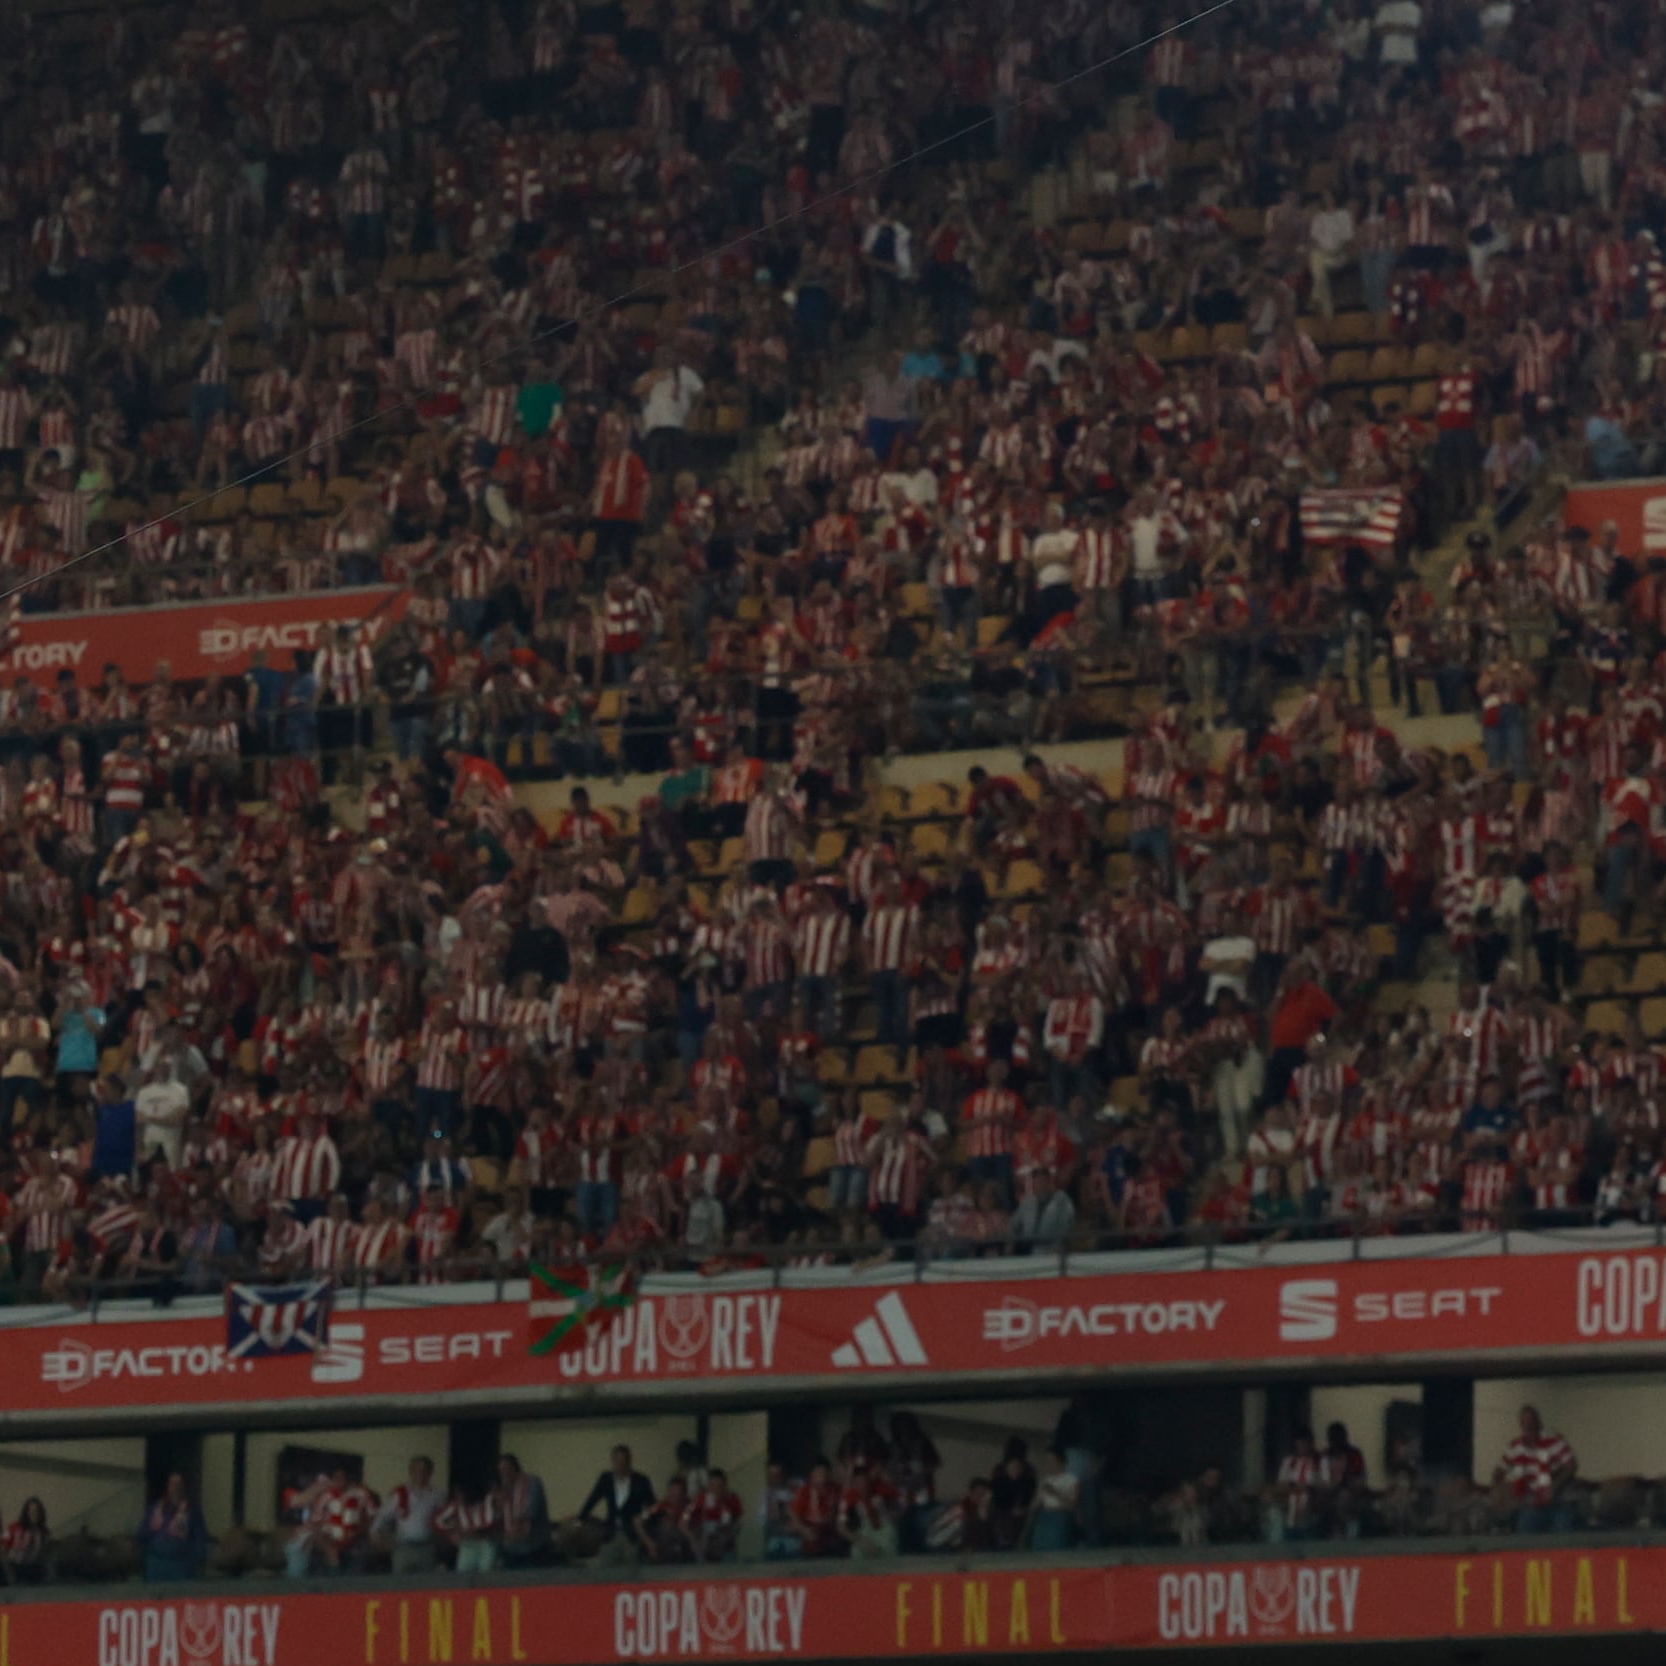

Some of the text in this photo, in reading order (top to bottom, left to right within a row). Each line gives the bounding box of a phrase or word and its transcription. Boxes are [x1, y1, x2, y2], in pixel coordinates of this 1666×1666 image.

[710, 1294, 782, 1369] REY
[1038, 1300, 1226, 1337] FACTORY
[1354, 1286, 1504, 1323] SEAT
[380, 1330, 514, 1365] SEAT
[615, 1588, 806, 1657] COPA REY
[896, 1579, 1067, 1647] FINAL
[1158, 1567, 1361, 1640] COPA REY
[1455, 1558, 1636, 1628] FINAL
[365, 1596, 527, 1663] FINAL
